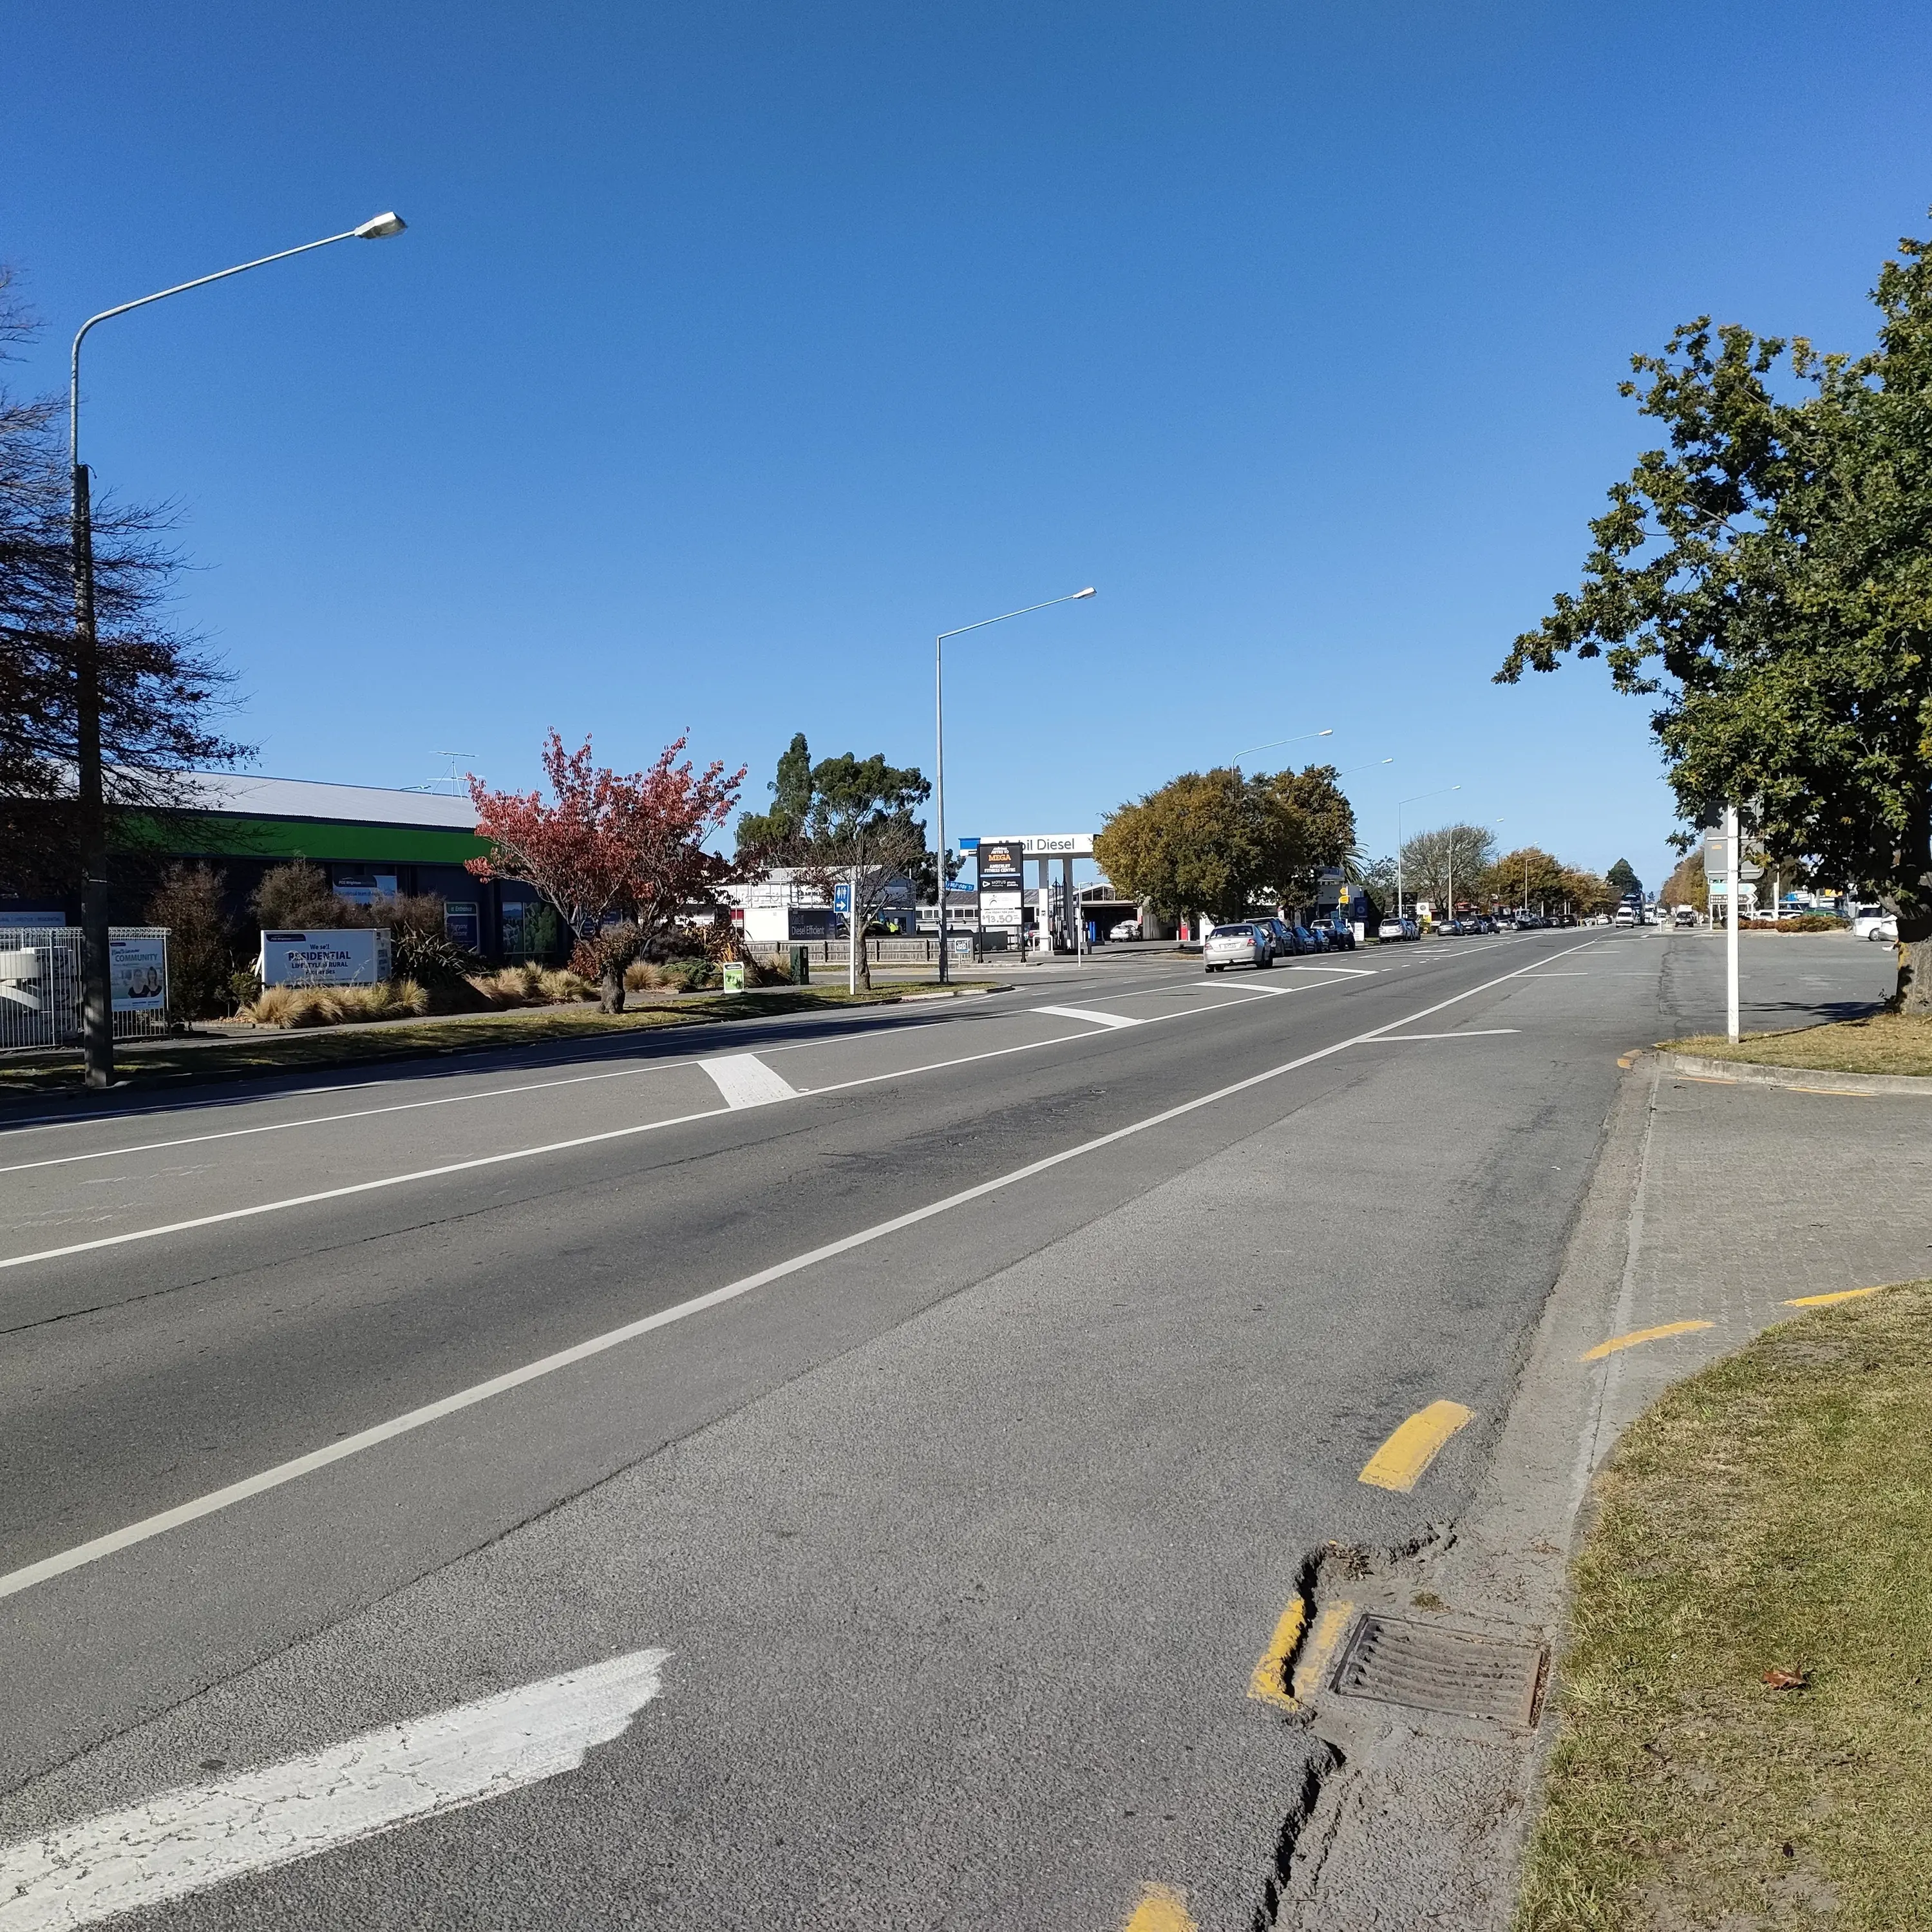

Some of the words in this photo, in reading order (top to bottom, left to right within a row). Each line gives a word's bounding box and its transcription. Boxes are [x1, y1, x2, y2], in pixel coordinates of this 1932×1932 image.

[1037, 838, 1074, 850] Diesel
[982, 914, 1013, 923] $13.50
[791, 925, 806, 935] Diesel
[806, 925, 825, 935] Efficient
[289, 951, 351, 961] RSIDENTIAL
